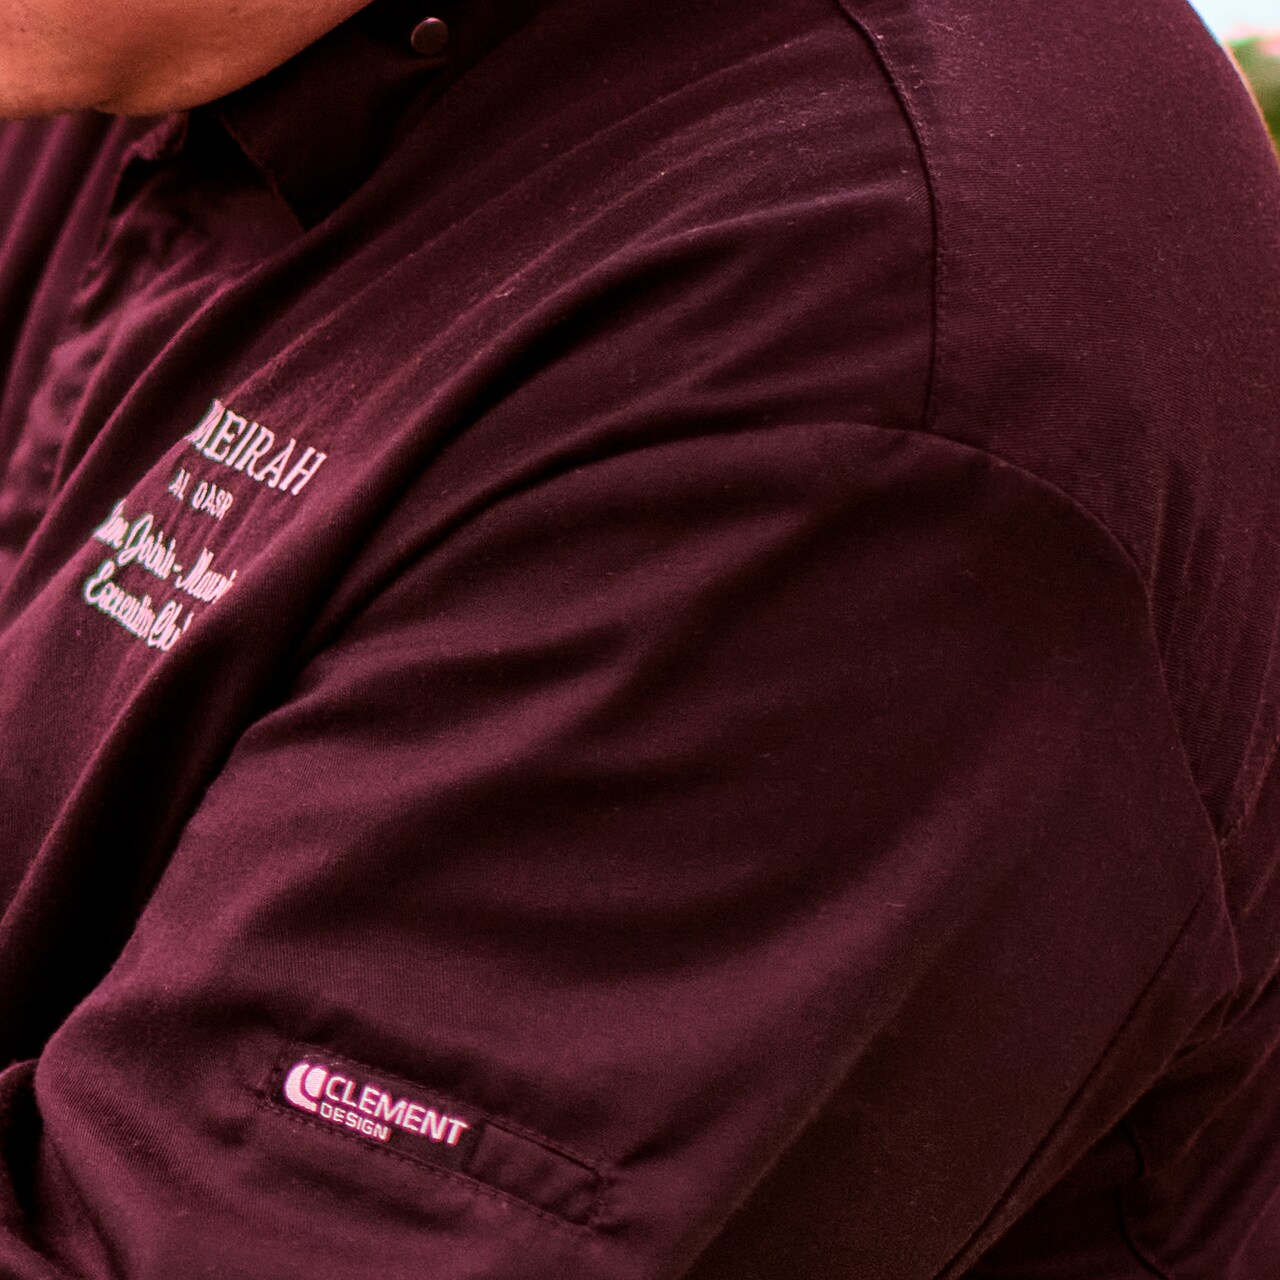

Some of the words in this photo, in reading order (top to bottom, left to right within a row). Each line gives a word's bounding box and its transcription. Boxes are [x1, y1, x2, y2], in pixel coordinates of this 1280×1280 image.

[168, 468, 190, 500] AL
[192, 480, 234, 520] QASR
[319, 1102, 391, 1140] DESIGN
[324, 1075, 471, 1146] CLEMENT
